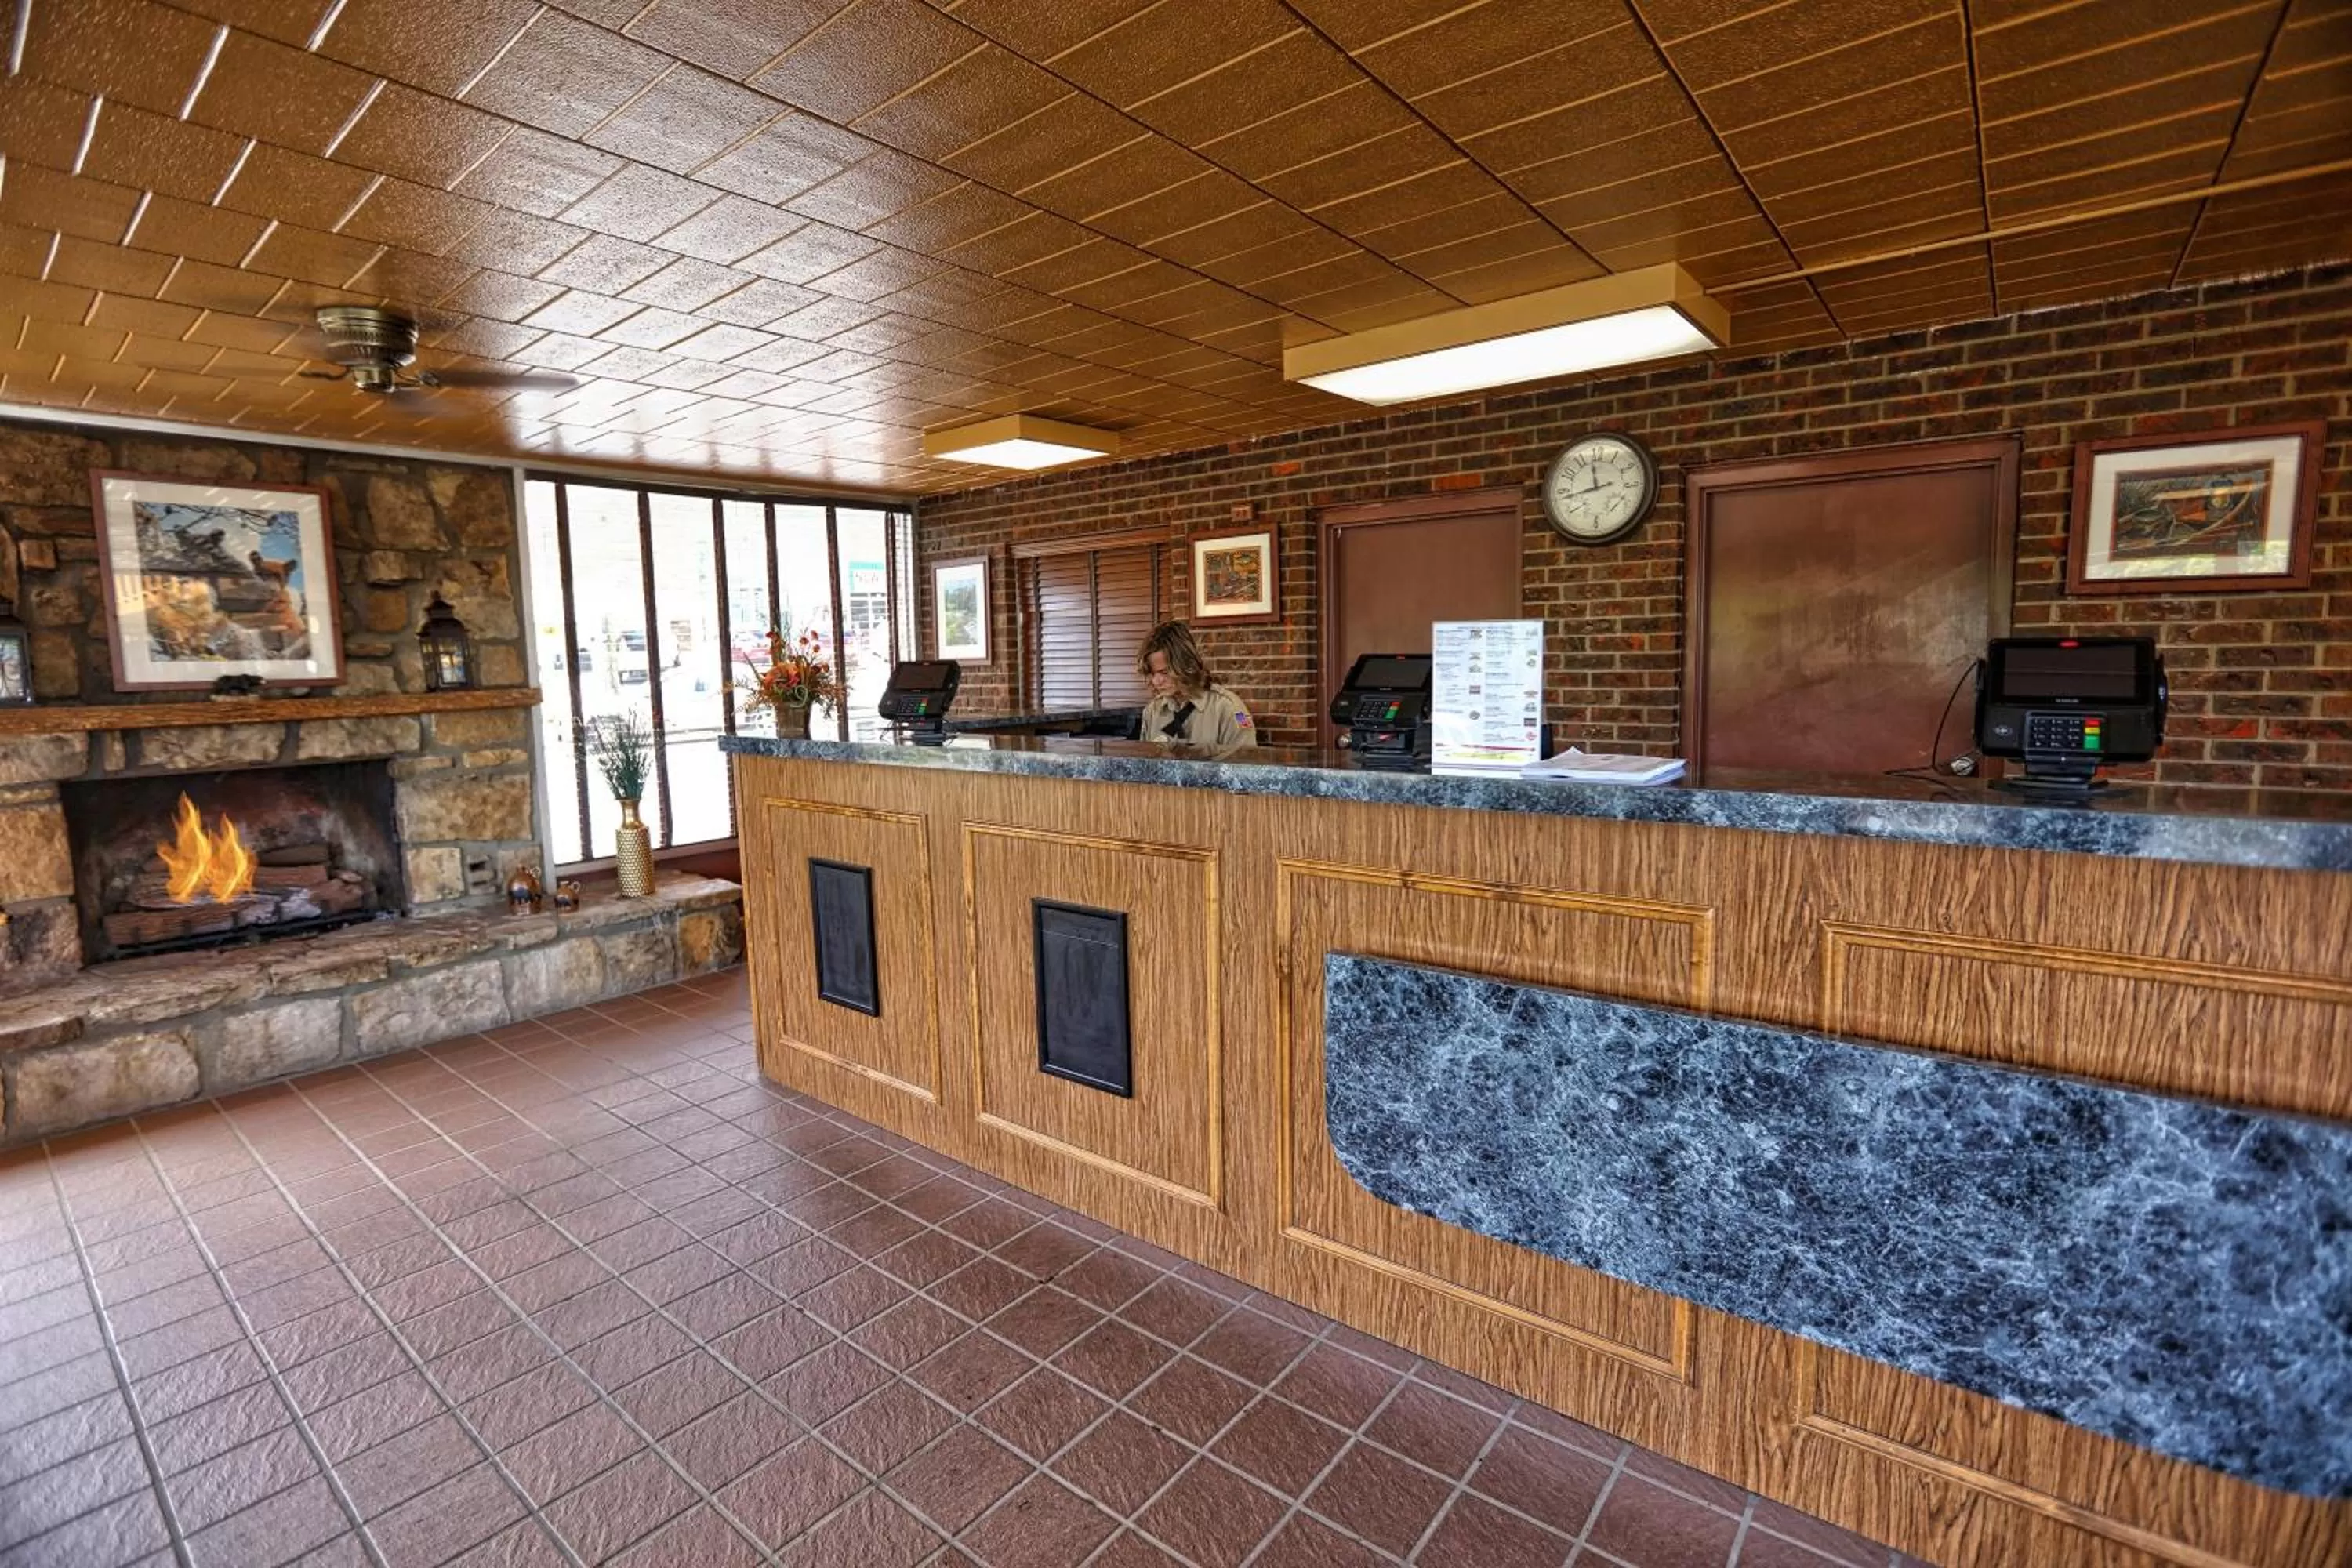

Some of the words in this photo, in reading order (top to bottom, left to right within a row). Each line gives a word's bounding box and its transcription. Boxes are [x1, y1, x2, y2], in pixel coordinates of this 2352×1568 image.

[1573, 454, 1588, 468] 11
[1592, 447, 1604, 462] 12
[1561, 467, 1576, 481] 10
